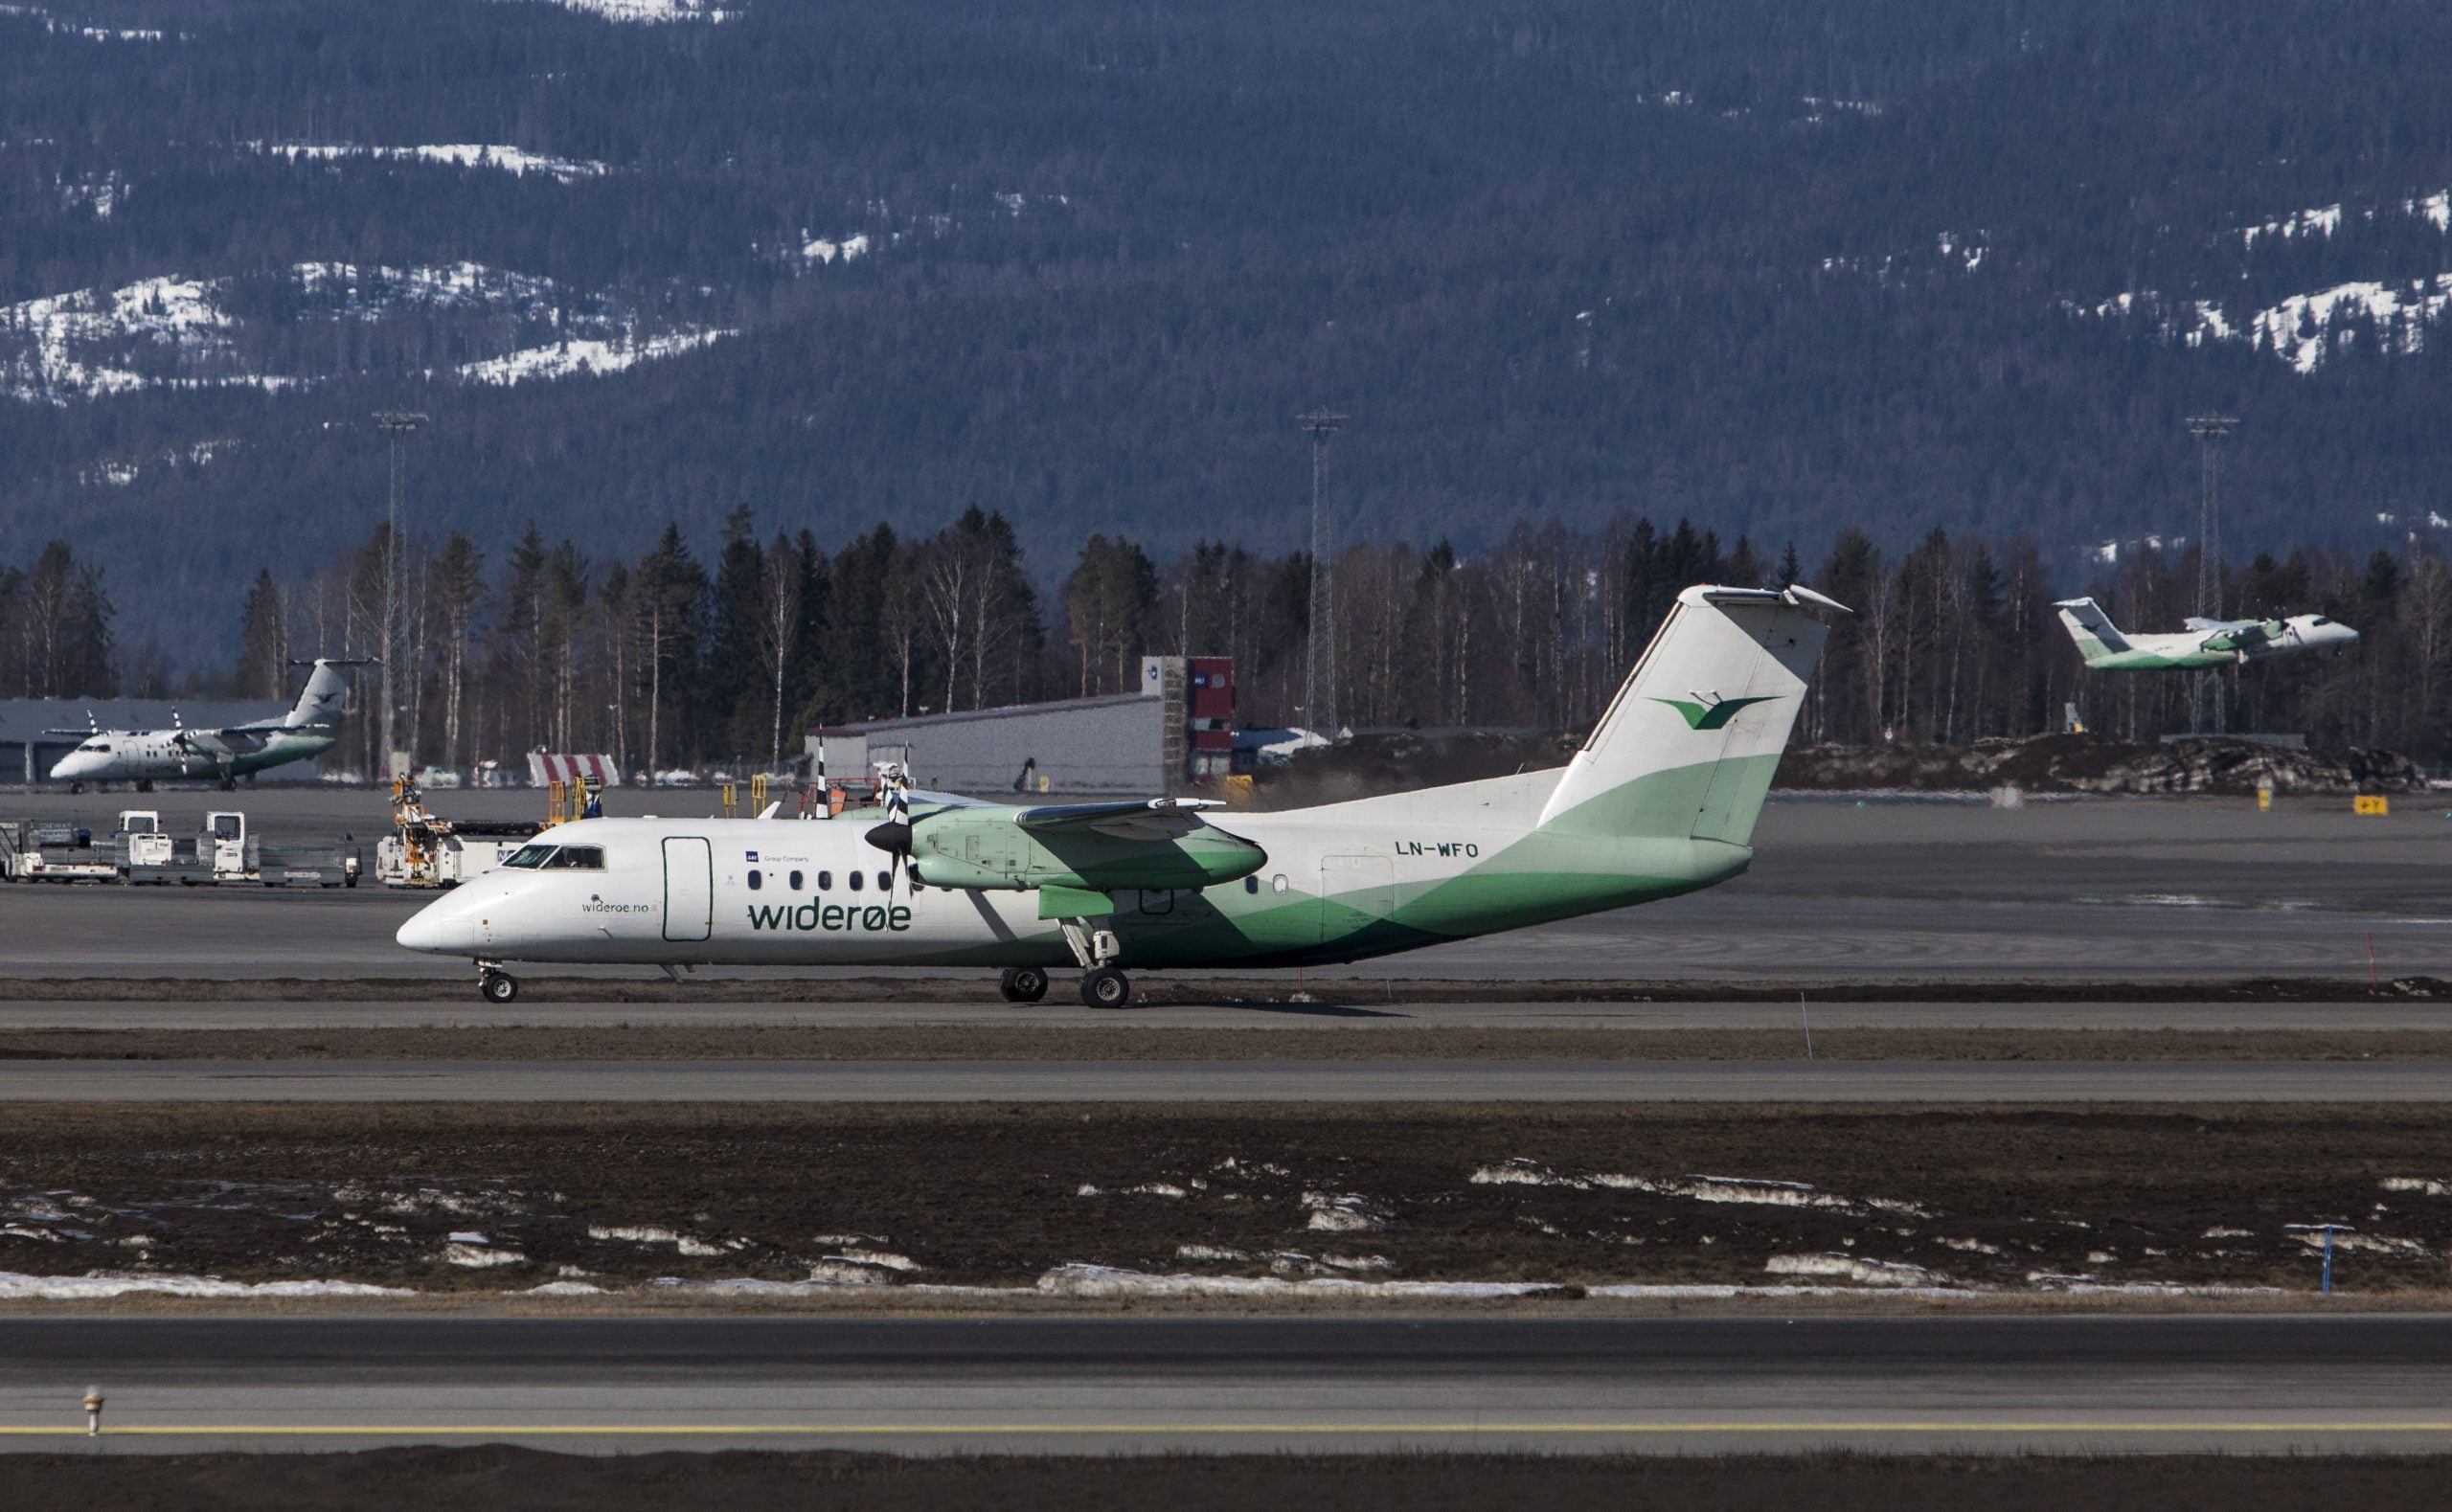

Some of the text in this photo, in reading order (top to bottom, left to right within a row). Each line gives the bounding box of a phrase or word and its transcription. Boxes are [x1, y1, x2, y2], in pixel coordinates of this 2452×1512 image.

[1395, 841, 1479, 858] LN-WFO
[581, 901, 649, 913] wideroe.no
[747, 895, 911, 931] widerøe
